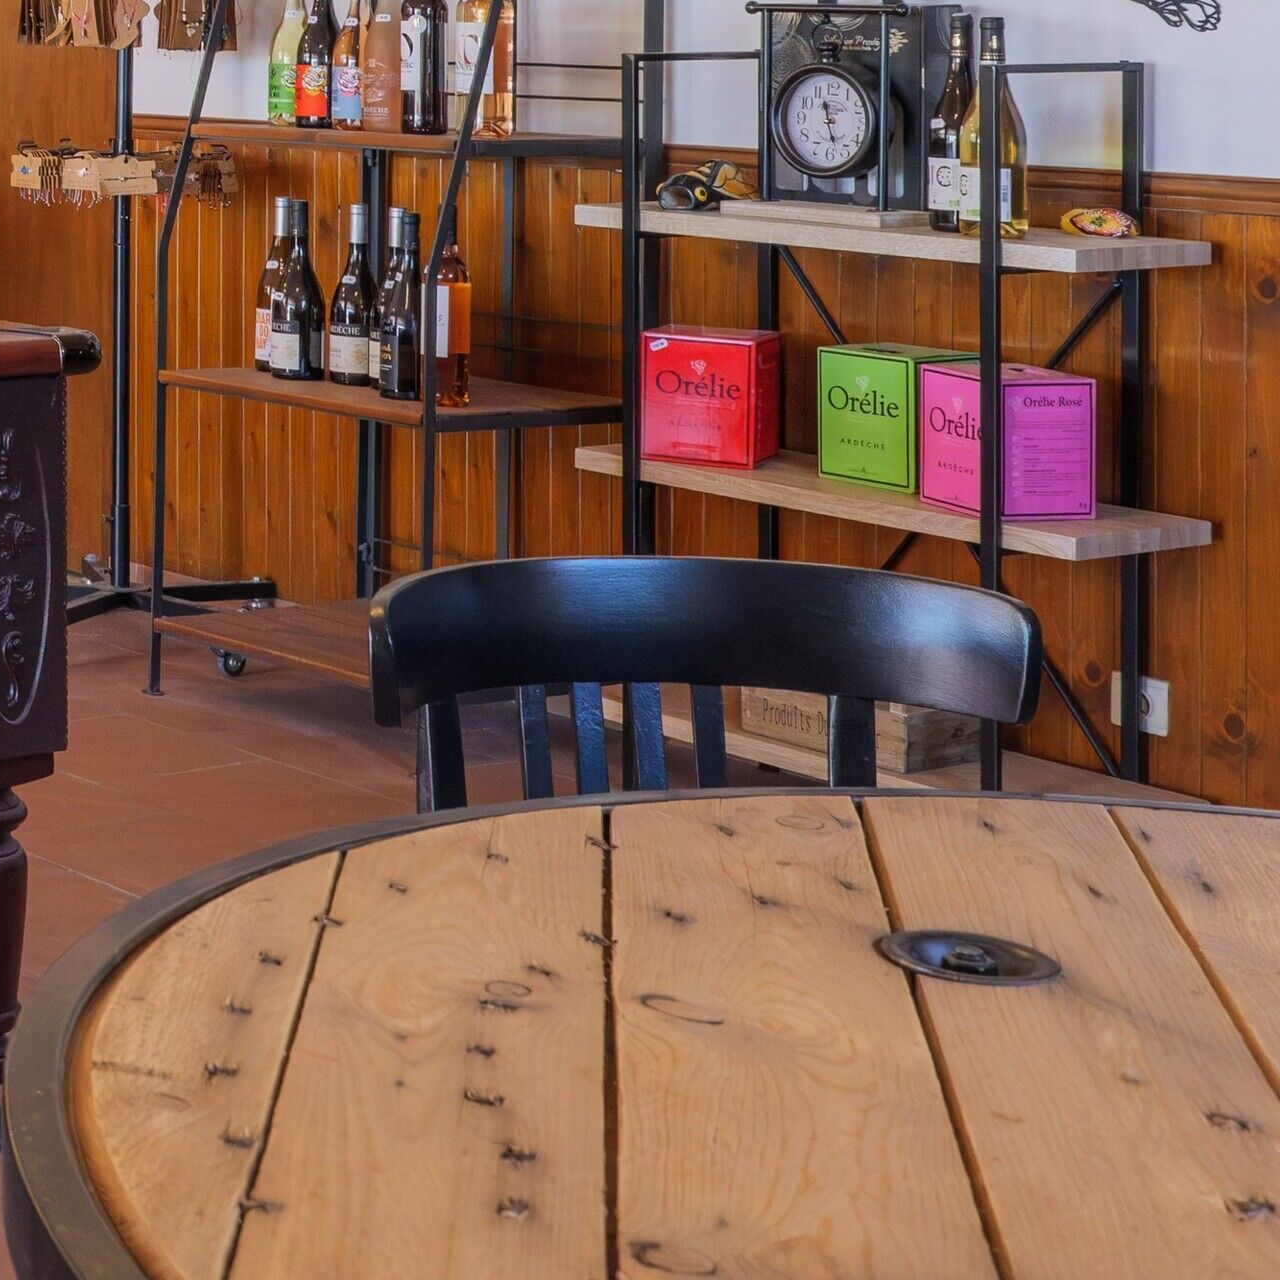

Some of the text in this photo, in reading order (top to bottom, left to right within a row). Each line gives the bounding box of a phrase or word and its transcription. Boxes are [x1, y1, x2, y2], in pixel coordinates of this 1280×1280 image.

[814, 85, 822, 99] 11
[827, 82, 840, 96] 12
[801, 96, 814, 110] 10
[854, 101, 864, 115] 2
[796, 111, 807, 125] 9
[800, 128, 810, 142] 8
[812, 141, 821, 156] 7
[825, 146, 835, 161] 6
[840, 143, 850, 158] 5
[656, 370, 741, 400] Orélie
[828, 385, 900, 418] Orélie
[762, 697, 811, 733] Produits
